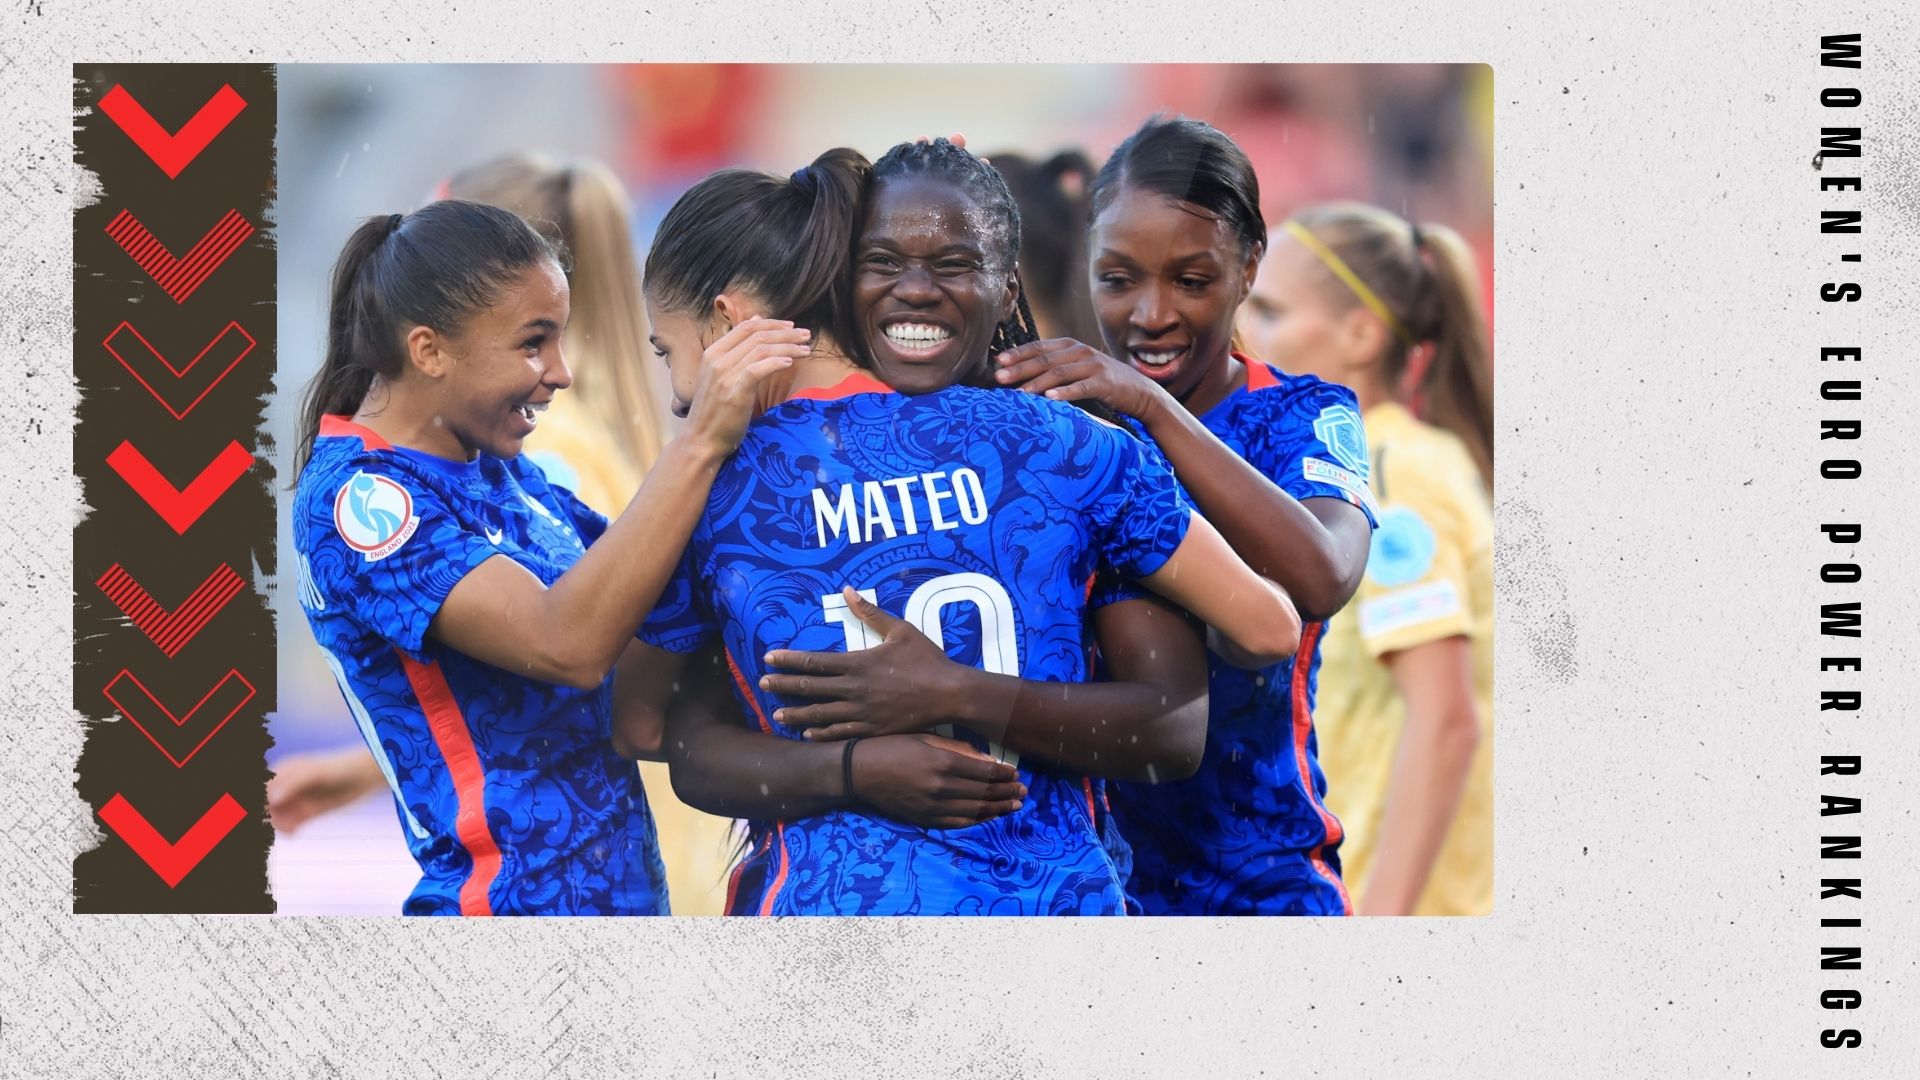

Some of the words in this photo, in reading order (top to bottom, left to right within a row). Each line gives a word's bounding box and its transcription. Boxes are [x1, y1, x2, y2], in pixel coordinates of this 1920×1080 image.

[812, 467, 989, 549] MATEO
[370, 538, 402, 560] ENGLAND
[402, 521, 417, 539] 2022
